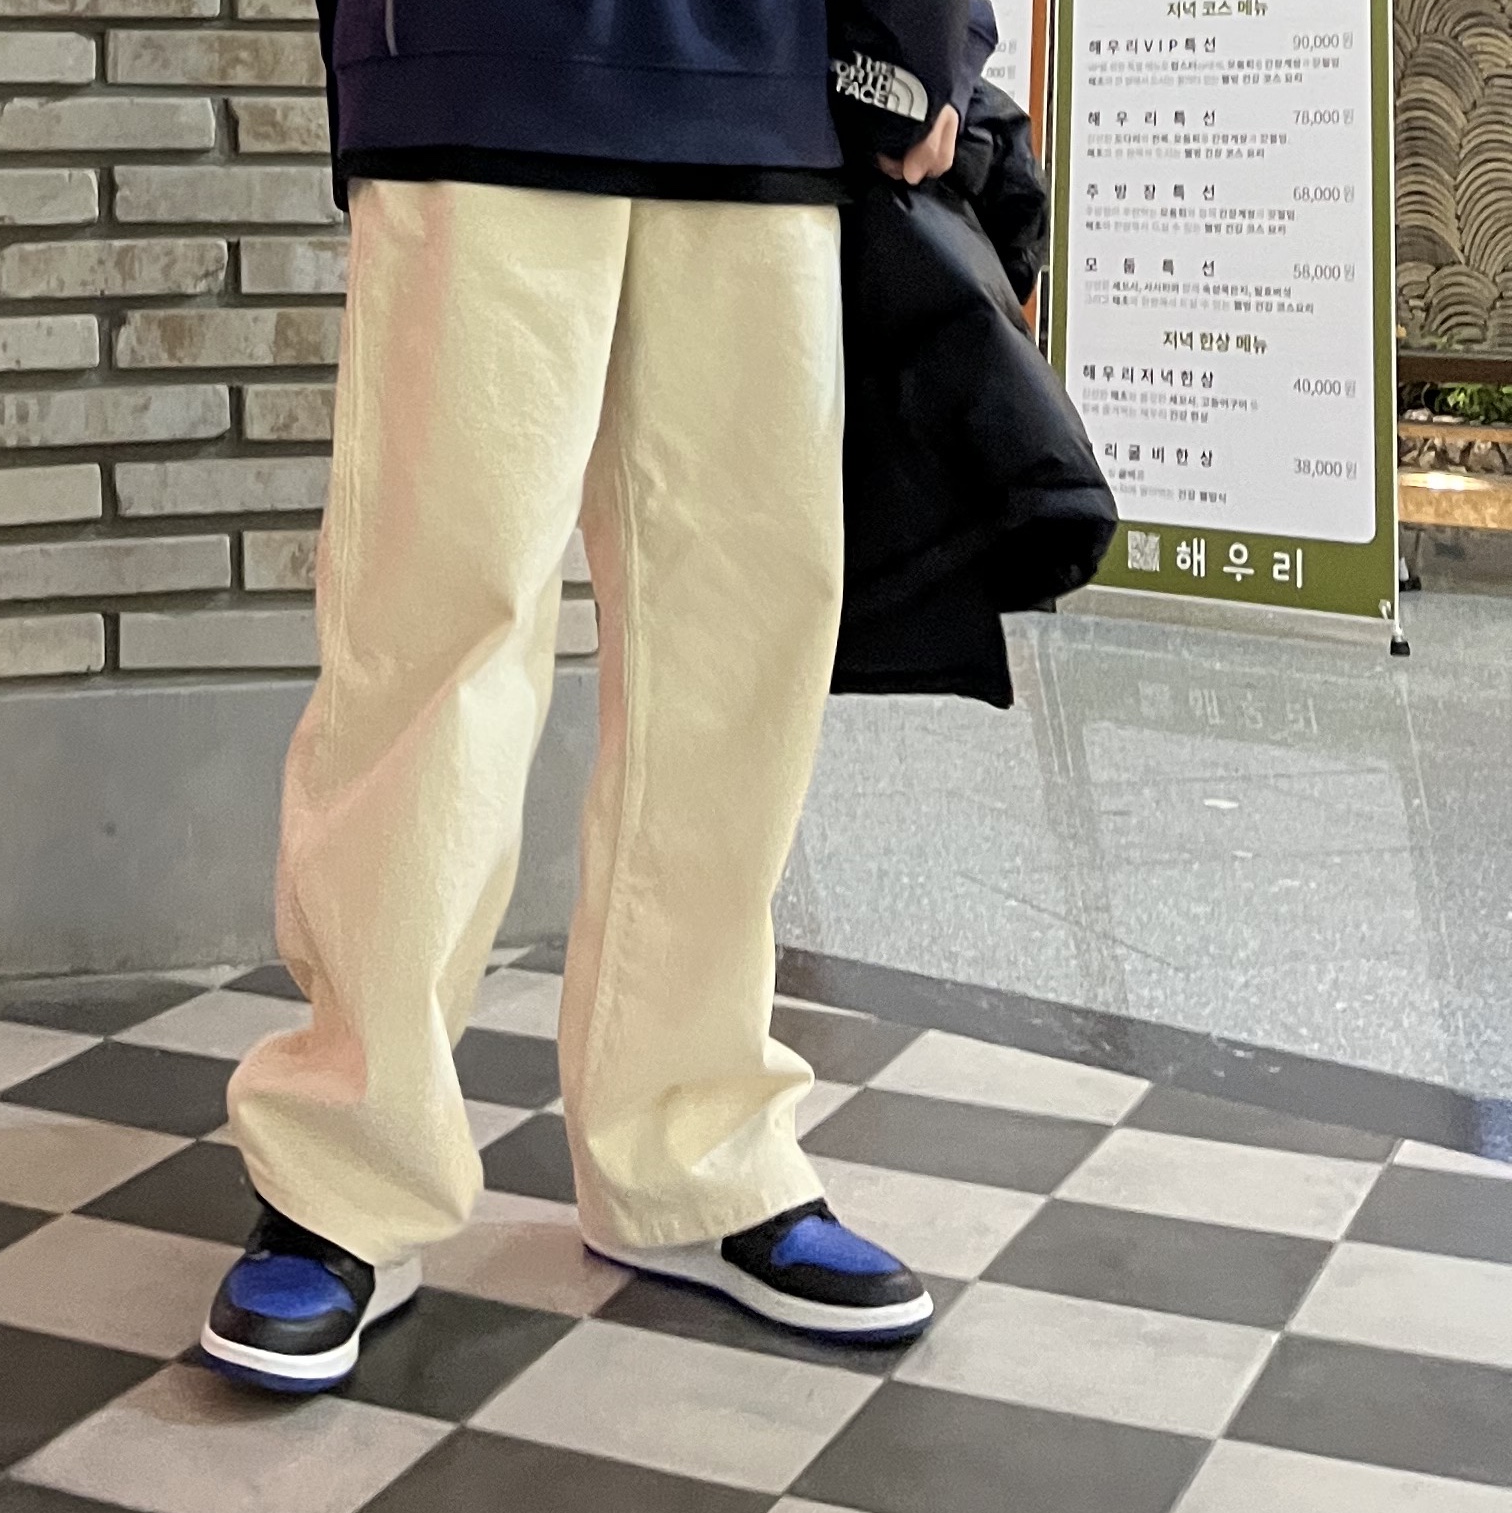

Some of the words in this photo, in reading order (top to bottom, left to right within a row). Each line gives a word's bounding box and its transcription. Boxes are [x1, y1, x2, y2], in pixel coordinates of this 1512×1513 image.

[1166, 0, 1197, 19] 저녁
[1202, 0, 1233, 17] 코스
[836, 76, 889, 109] FACE
[1162, 330, 1194, 351] 저녁
[1199, 332, 1231, 353] 한상
[1235, 333, 1269, 355] 메뉴
